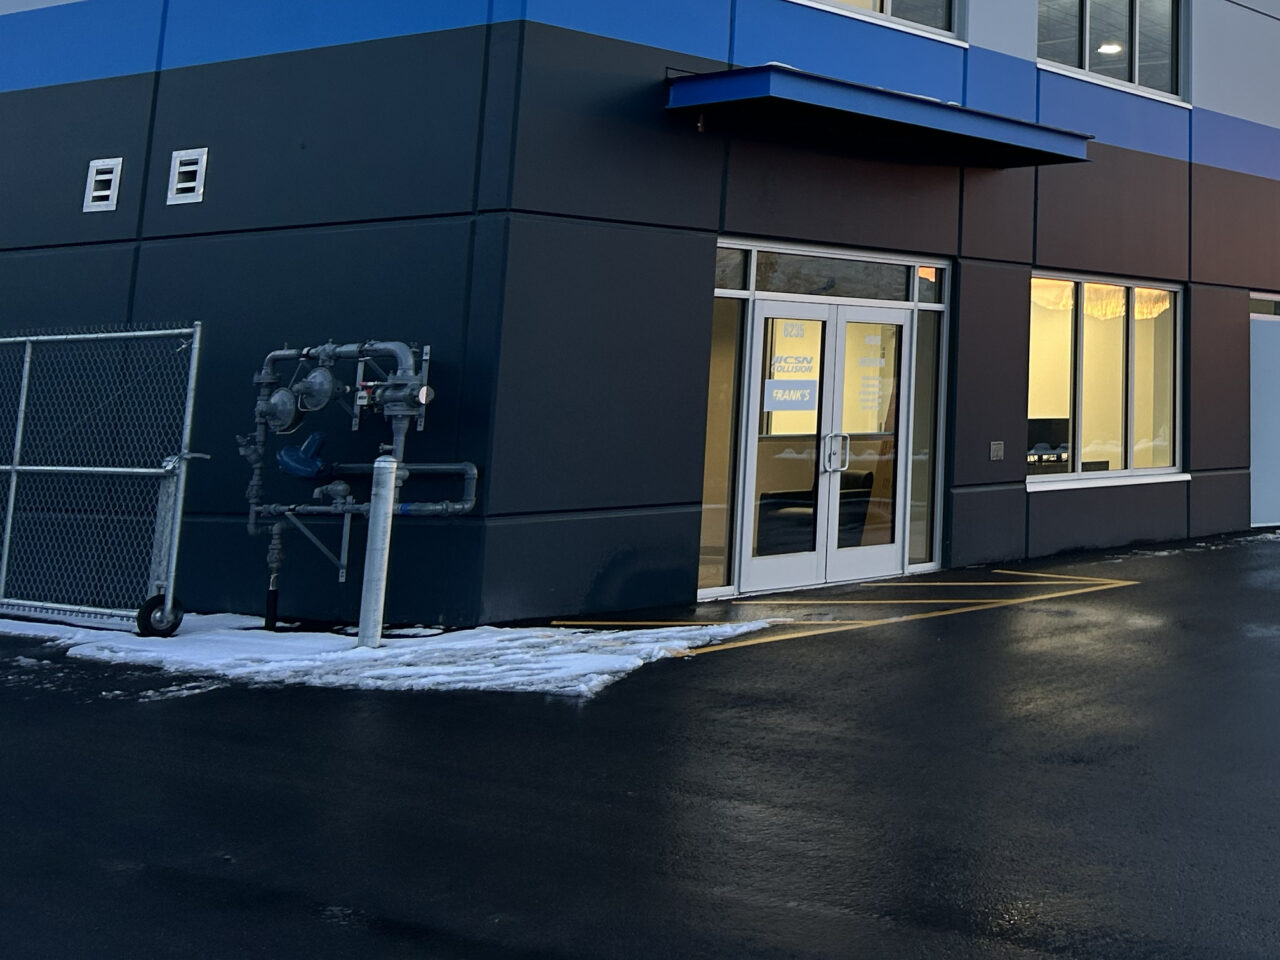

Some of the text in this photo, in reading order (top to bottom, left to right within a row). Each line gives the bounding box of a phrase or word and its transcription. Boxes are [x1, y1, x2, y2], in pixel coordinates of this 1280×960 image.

[783, 356, 813, 365] CSN
[771, 365, 813, 373] COLLISION
[773, 389, 810, 401] FRANK'S
